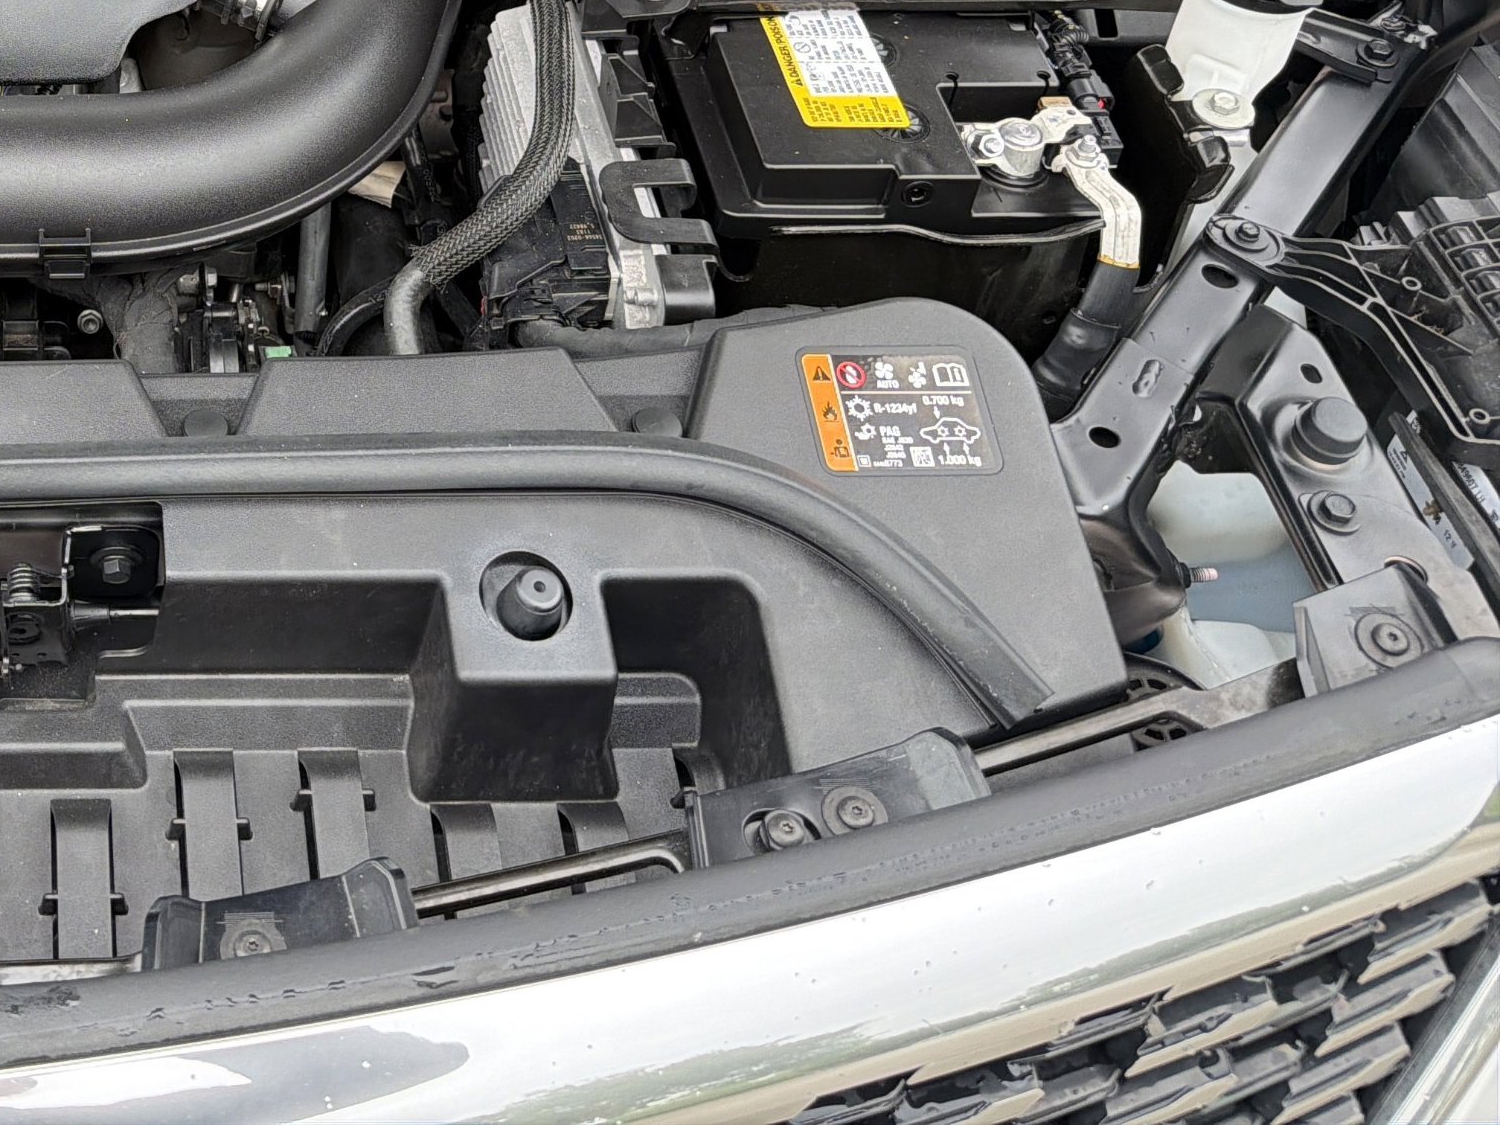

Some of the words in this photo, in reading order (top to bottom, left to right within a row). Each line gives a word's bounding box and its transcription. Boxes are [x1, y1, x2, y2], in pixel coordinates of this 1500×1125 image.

[876, 379, 900, 389] AUTO
[922, 395, 950, 405] 0.700
[950, 395, 964, 407] kg
[873, 403, 918, 415] R-1234yf
[879, 425, 901, 437] PAG
[938, 455, 967, 465] 1.000
[967, 455, 982, 467] kg
